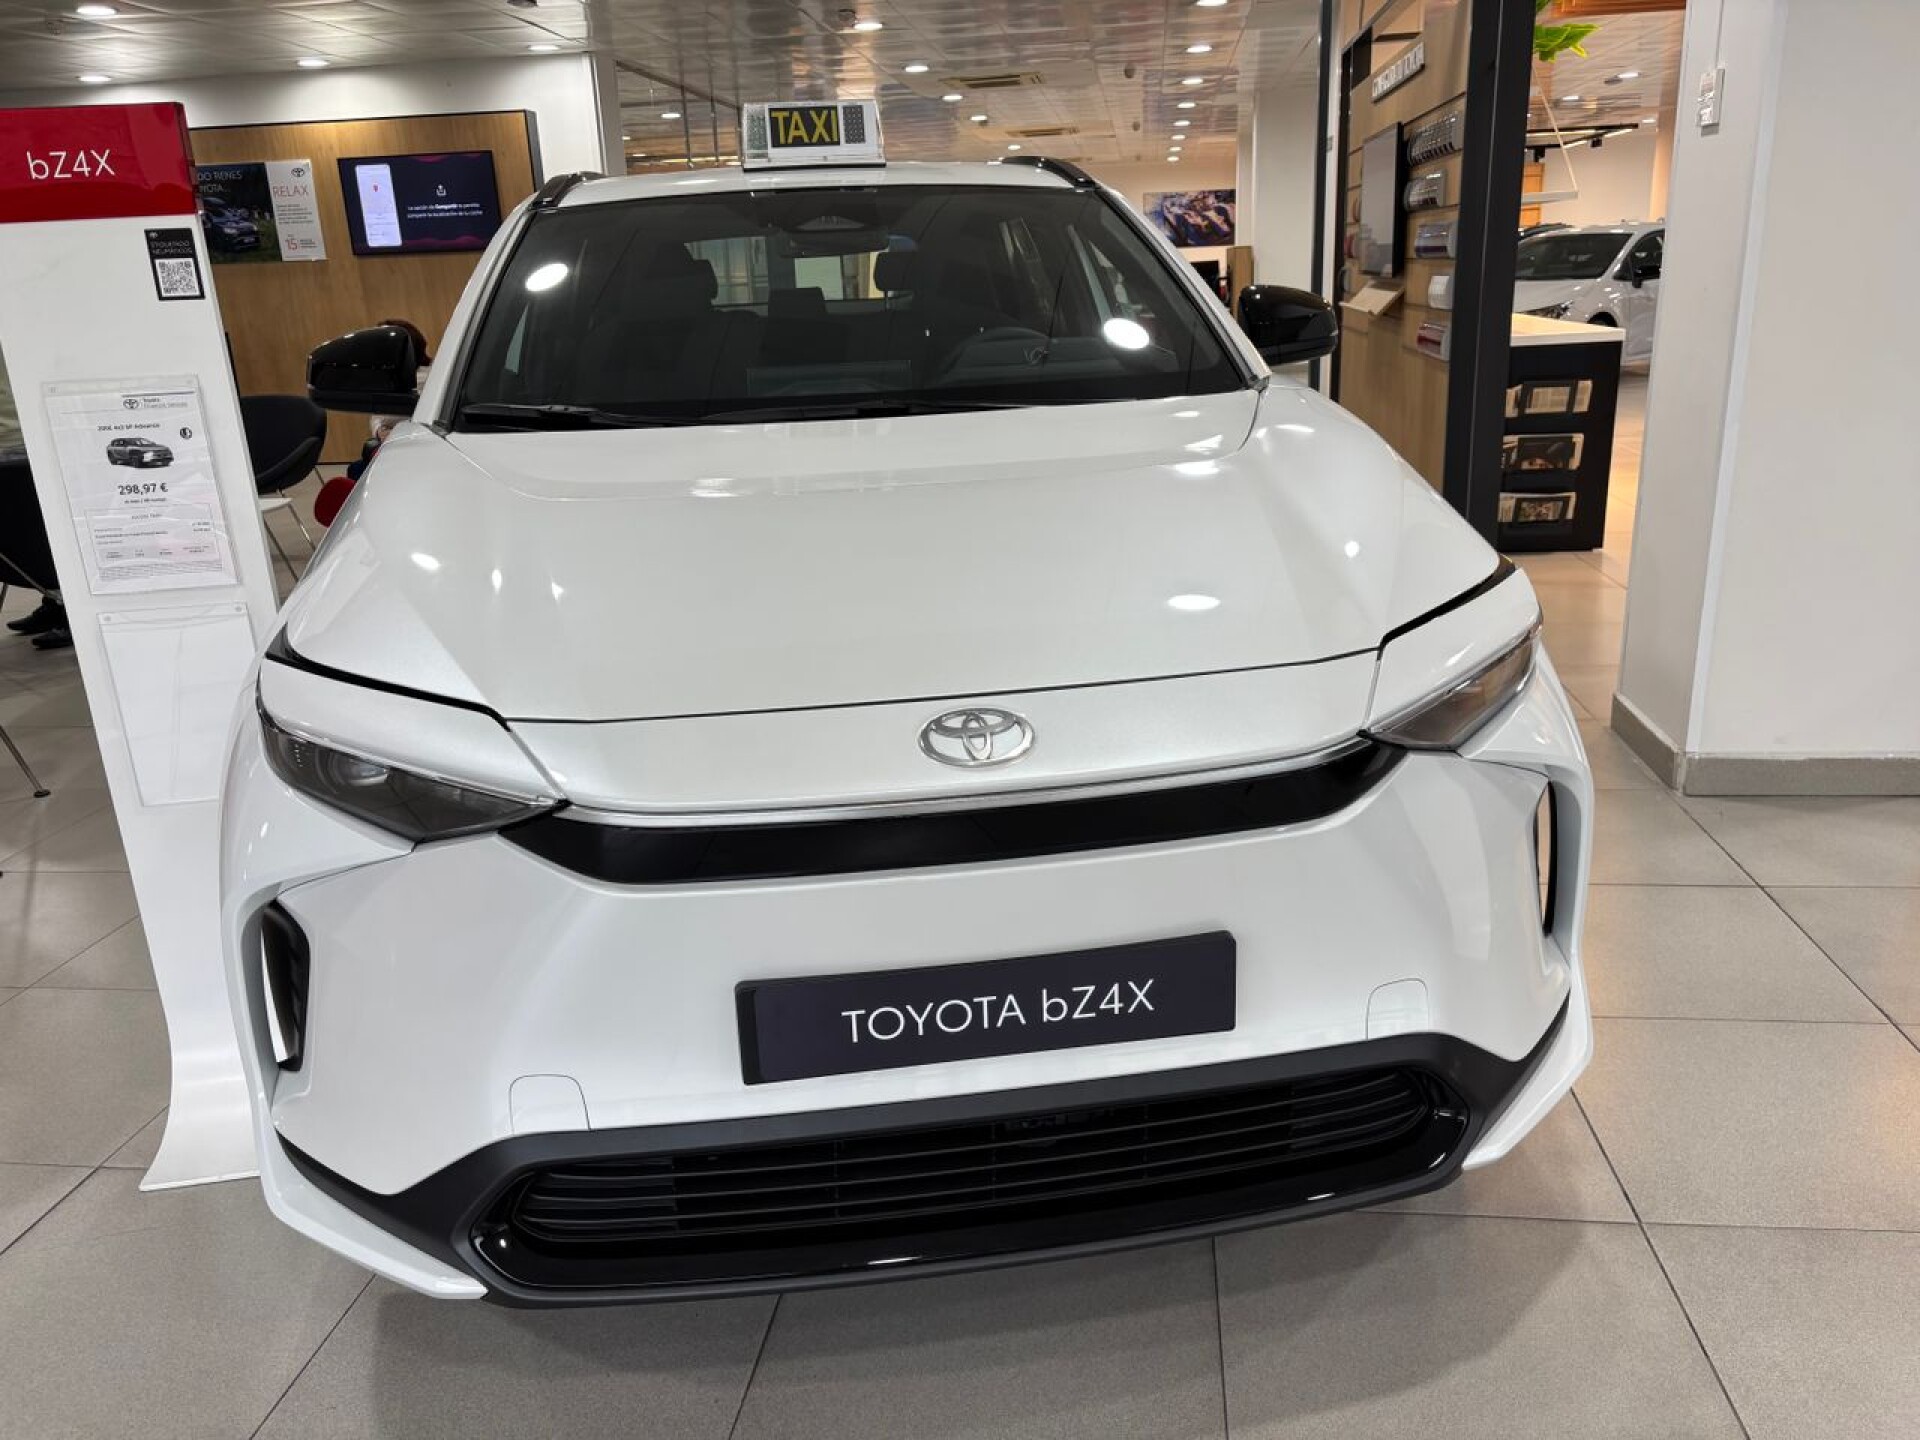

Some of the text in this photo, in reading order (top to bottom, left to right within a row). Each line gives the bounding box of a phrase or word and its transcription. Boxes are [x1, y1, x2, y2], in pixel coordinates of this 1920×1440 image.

[771, 110, 839, 145] TAXI
[26, 149, 115, 180] bZ4X
[272, 185, 310, 197] RELAX
[285, 238, 298, 251] 15
[117, 482, 169, 495] 298,97 €
[841, 979, 1155, 1044] TOYOTA bZ4X
